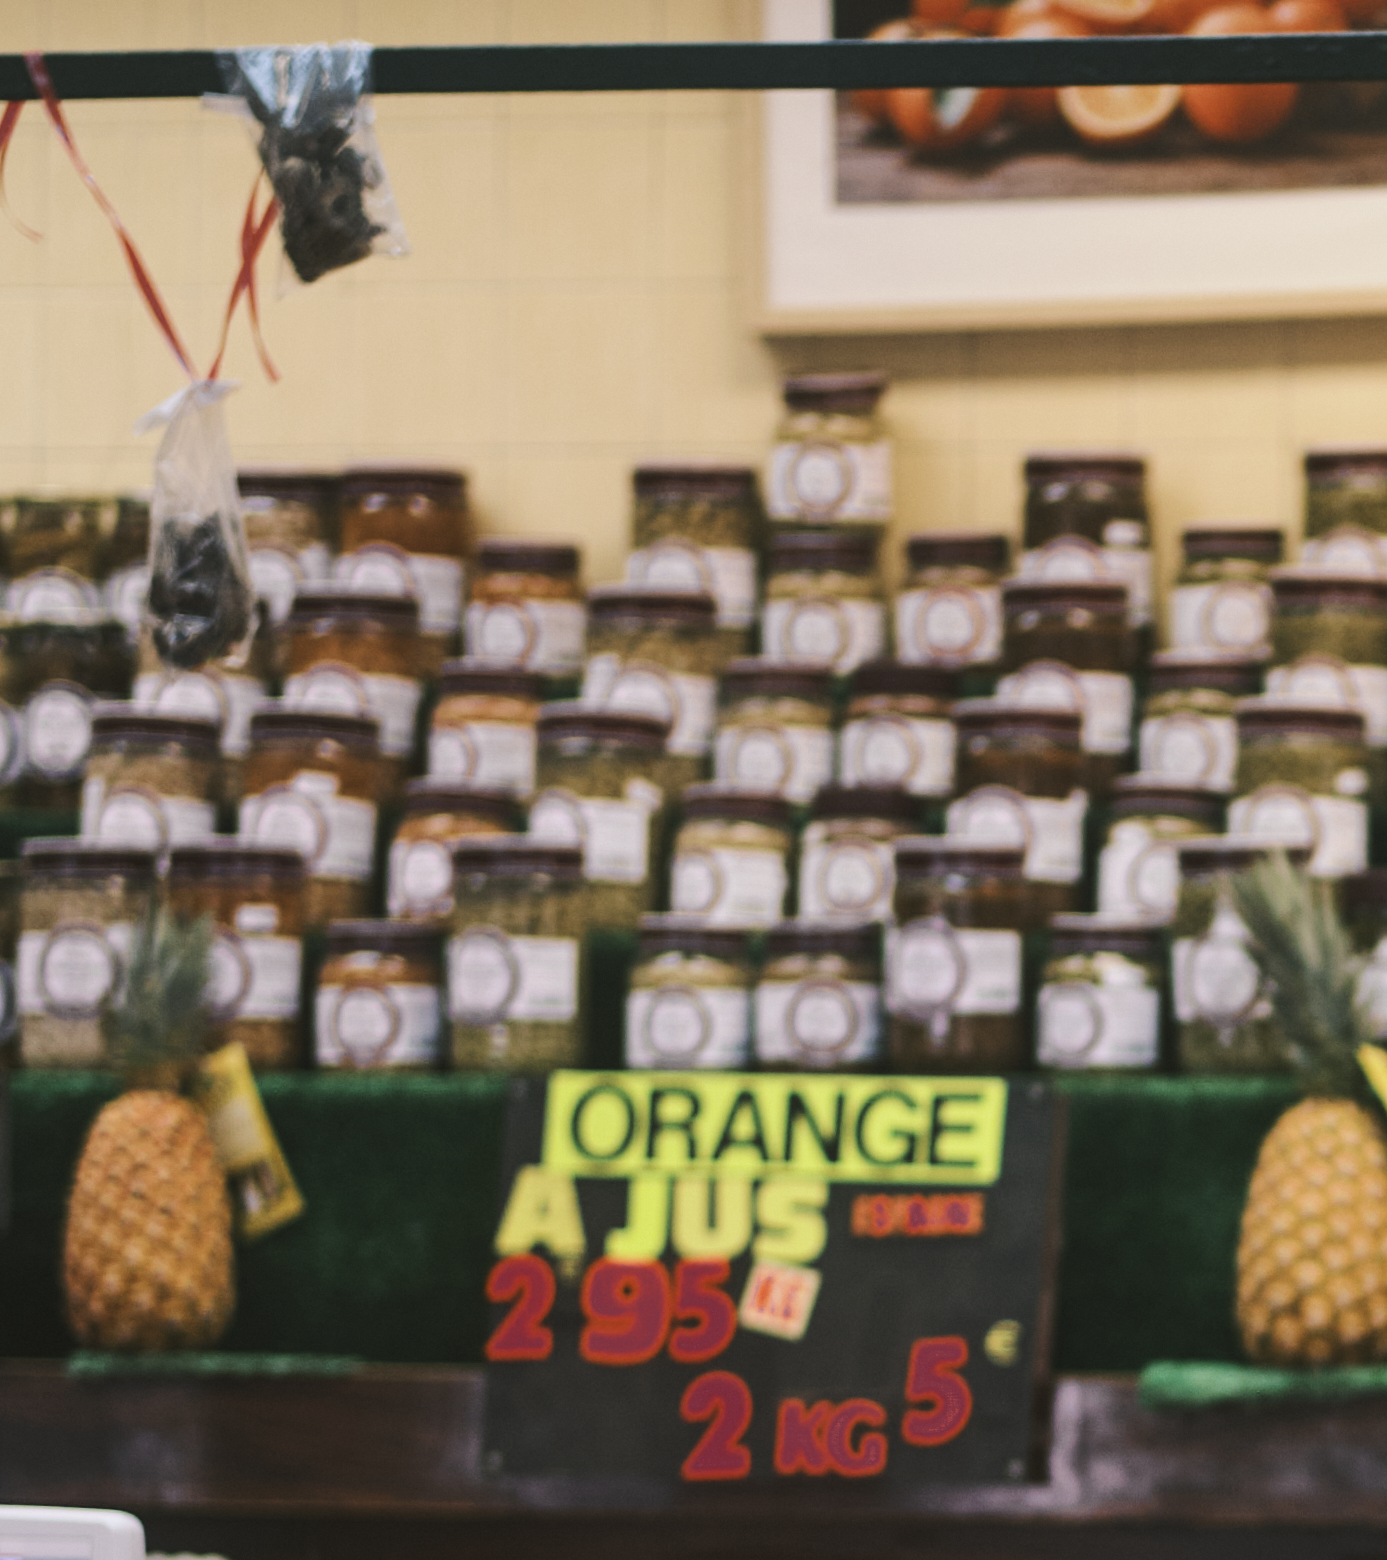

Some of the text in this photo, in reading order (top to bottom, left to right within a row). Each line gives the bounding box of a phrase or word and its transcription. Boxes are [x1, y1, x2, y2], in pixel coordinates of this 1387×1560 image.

[569, 1084, 985, 1168] ORANGE
[604, 1170, 830, 1264] JUS
[773, 1397, 888, 1478] KG
